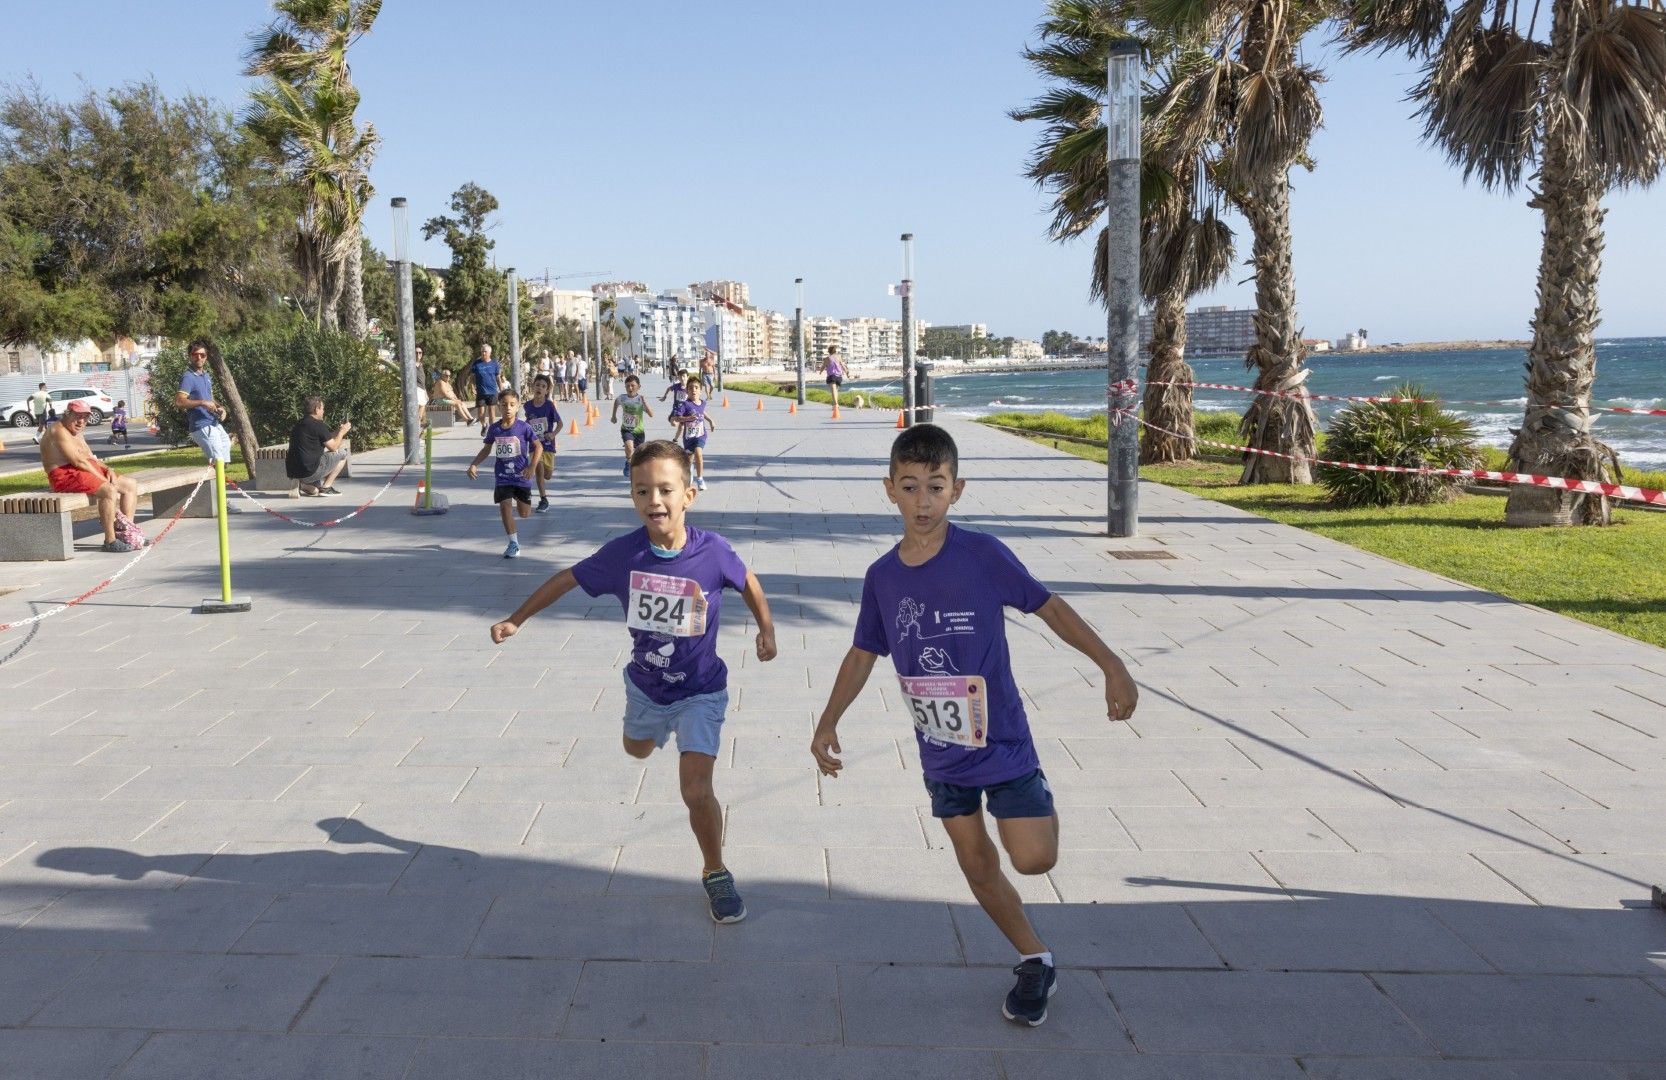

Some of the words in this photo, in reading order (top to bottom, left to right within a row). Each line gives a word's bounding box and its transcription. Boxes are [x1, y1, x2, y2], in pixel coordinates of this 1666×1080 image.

[496, 444, 513, 455] 506
[640, 577, 650, 590] X
[638, 594, 685, 626] 524
[905, 681, 915, 695] X
[911, 698, 963, 732] 513
